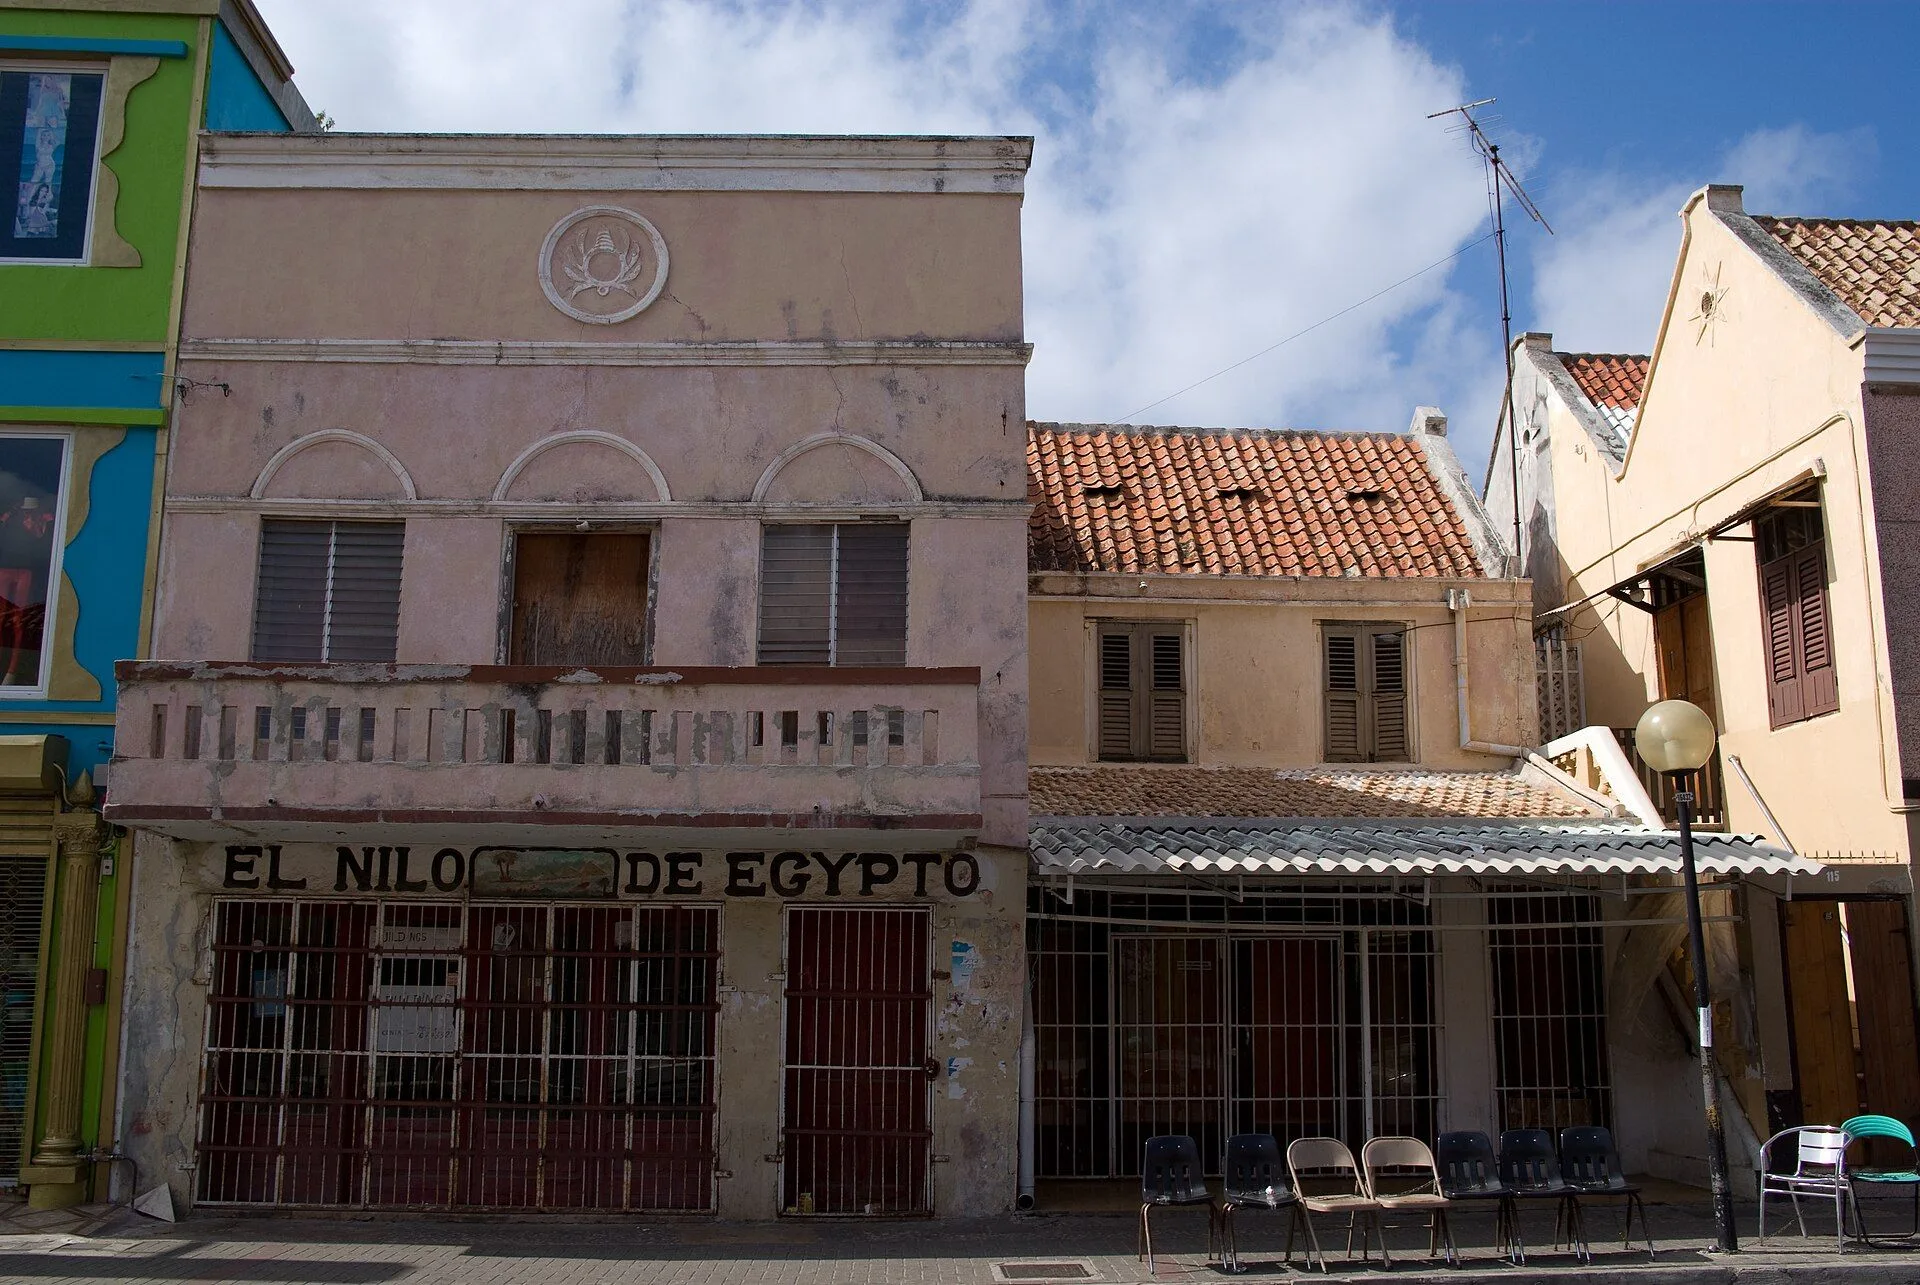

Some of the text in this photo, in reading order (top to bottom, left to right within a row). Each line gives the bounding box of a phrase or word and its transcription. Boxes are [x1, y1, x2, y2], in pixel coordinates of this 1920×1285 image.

[223, 845, 981, 898] EL NILO DE EGYPTO
[1825, 870, 1840, 882] 115
